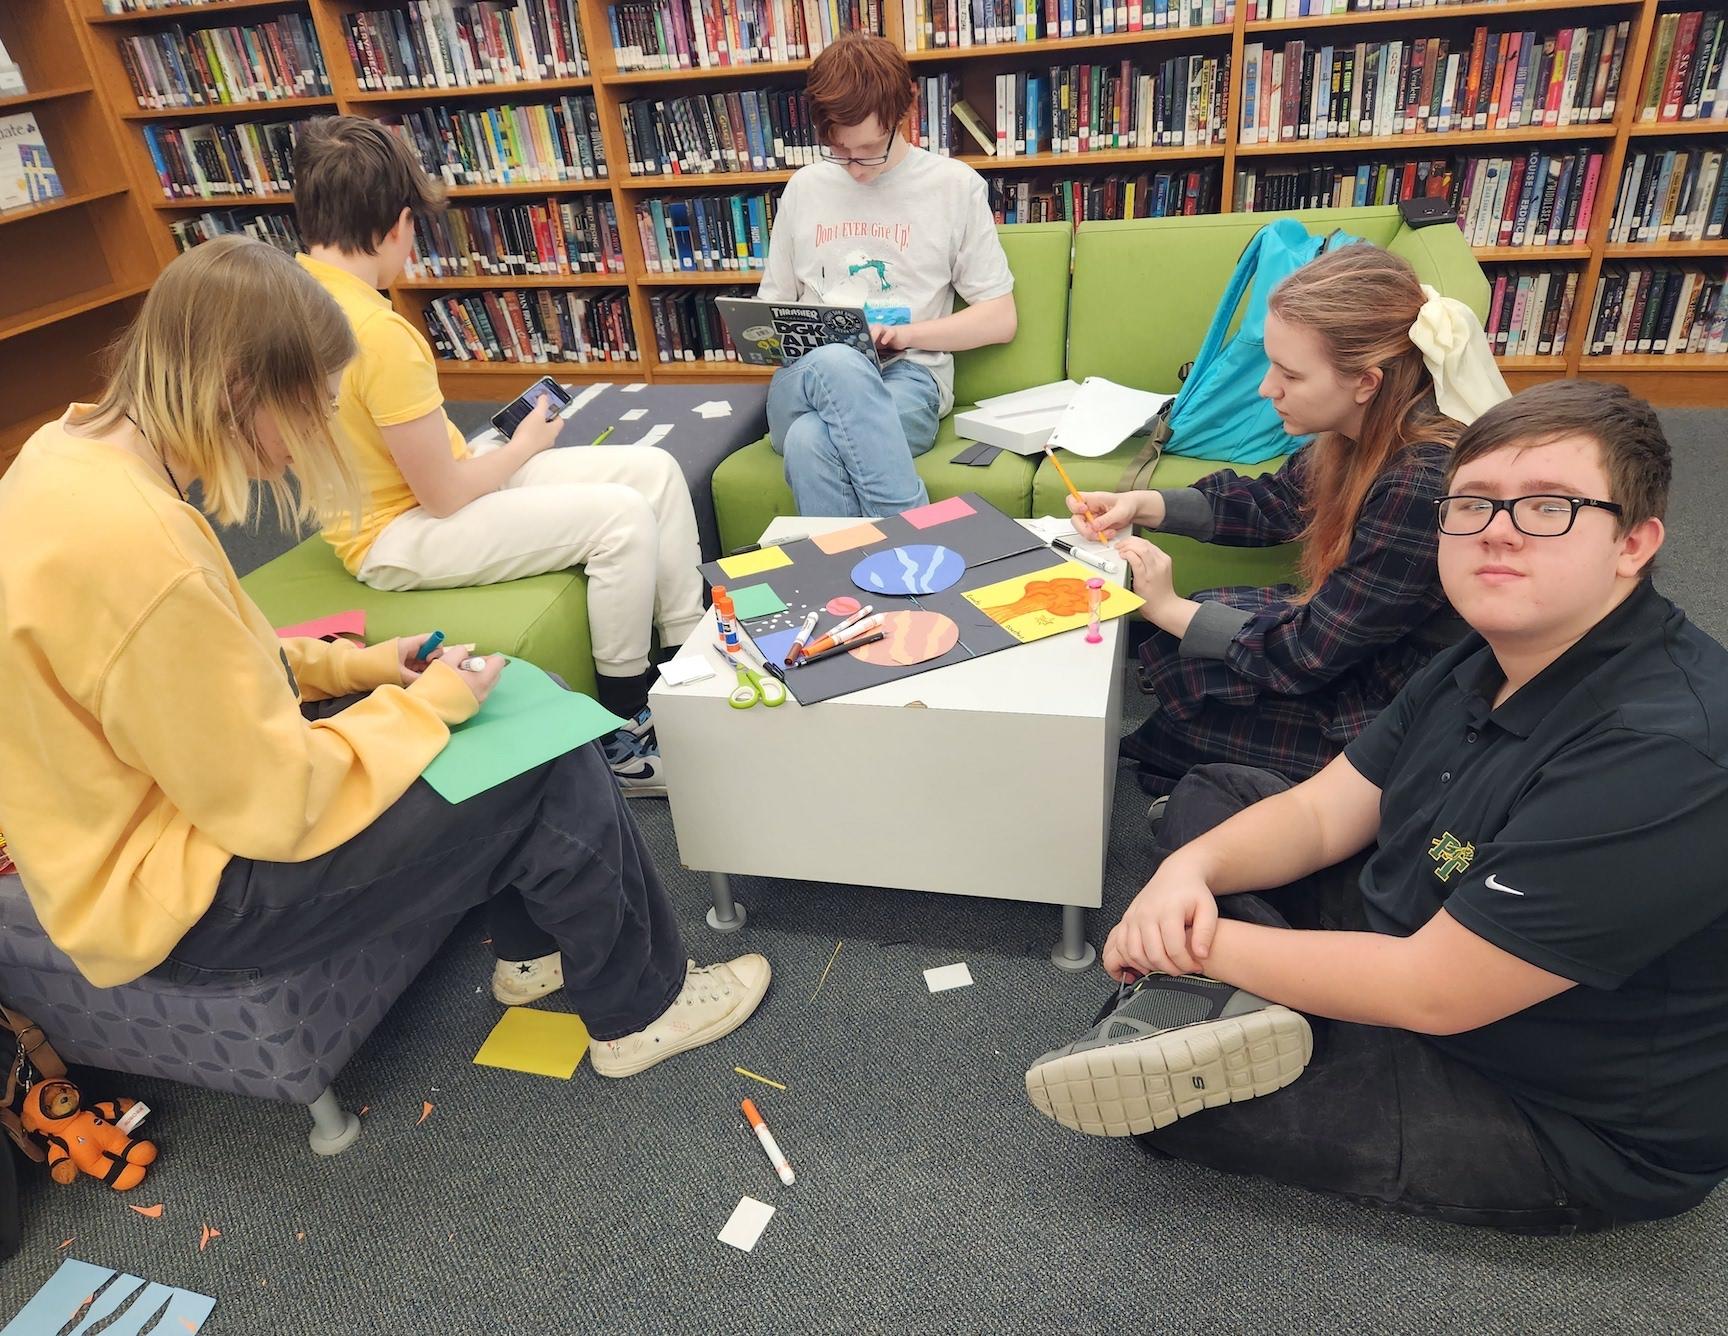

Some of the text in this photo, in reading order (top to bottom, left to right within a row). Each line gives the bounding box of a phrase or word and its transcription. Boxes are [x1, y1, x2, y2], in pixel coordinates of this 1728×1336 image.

[1700, 43, 1712, 71] RULES
[1408, 68, 1422, 104] Vendetta
[1517, 66, 1528, 81] HOT
[1672, 54, 1690, 104] SKY KEY
[1221, 71, 1230, 120] crackback
[1514, 84, 1524, 99] DOG
[1691, 88, 1700, 105] GAM
[788, 96, 796, 128] CHOSEN
[703, 113, 716, 151] BLOODLIN
[1516, 152, 1539, 233] LOUISE ERDRIC
[1540, 185, 1556, 222] MIDDLESEX
[1459, 197, 1469, 219] PET
[586, 206, 599, 248] RED RISING
[751, 226, 760, 243] HUSH
[842, 222, 868, 238] EVER
[871, 223, 891, 239] Give
[894, 223, 911, 252] Up!
[519, 293, 528, 309] DAN
[771, 307, 819, 320] THRASHER
[774, 321, 828, 338] DGK
